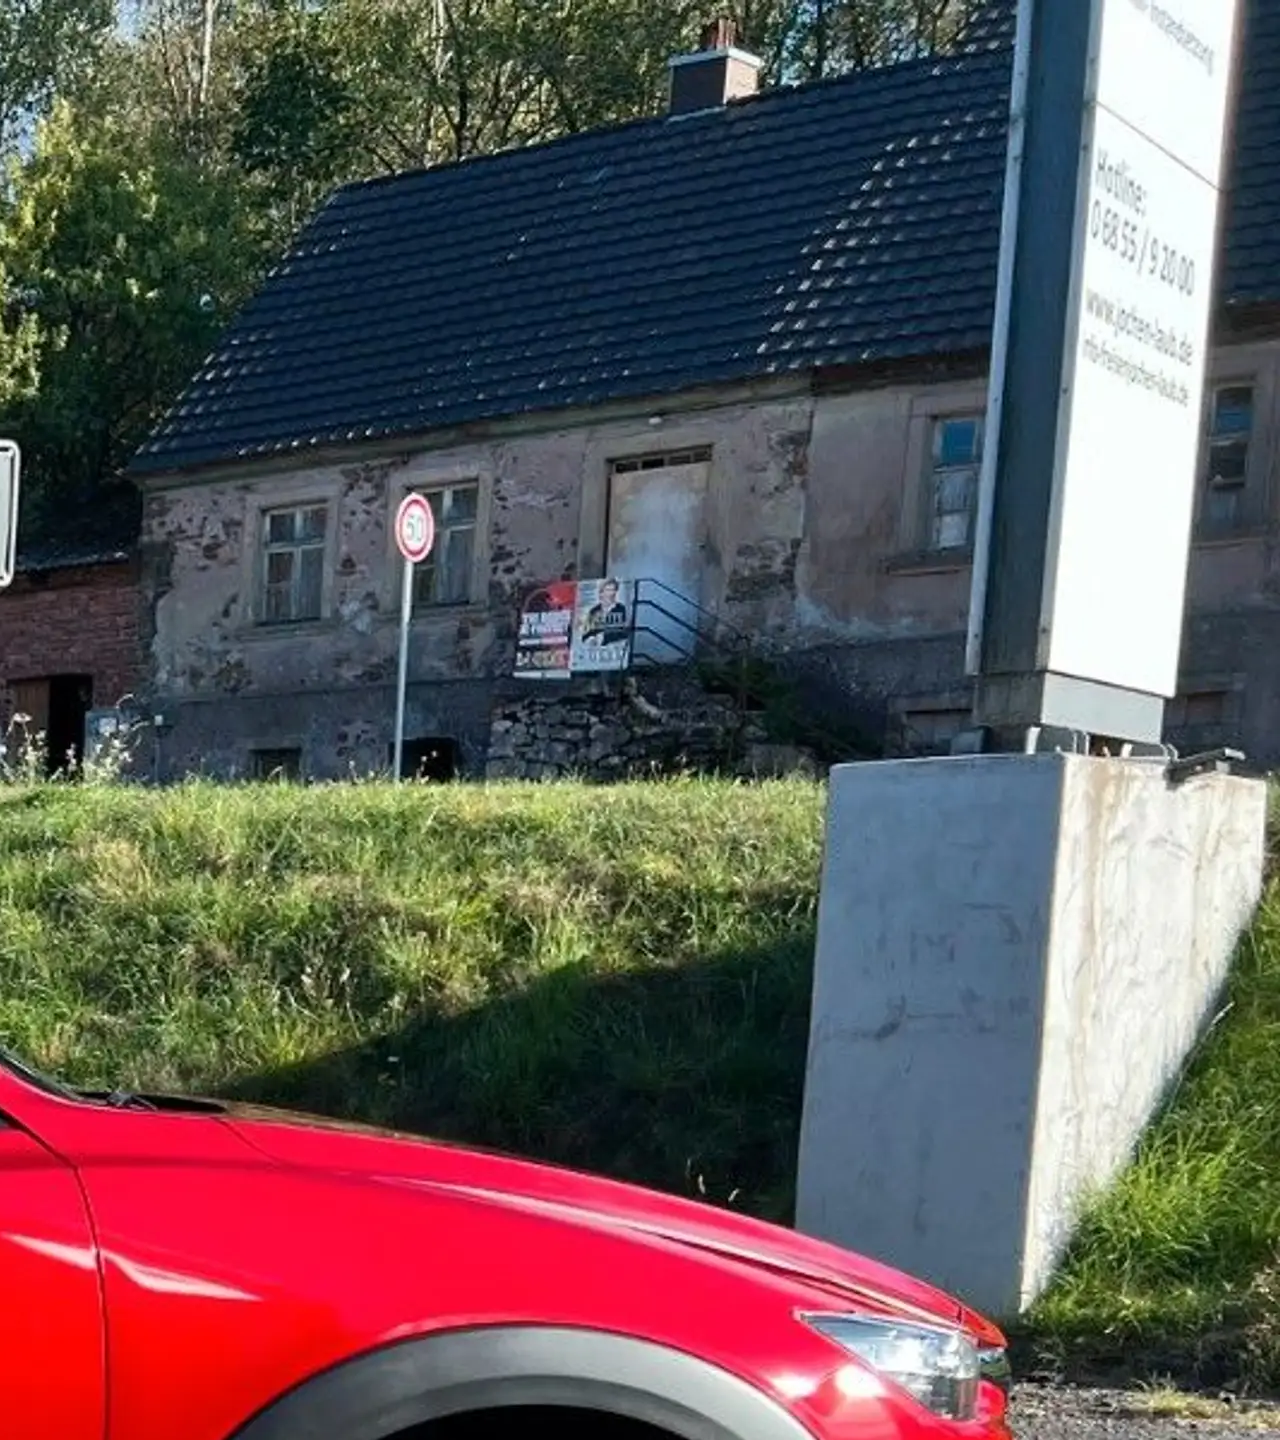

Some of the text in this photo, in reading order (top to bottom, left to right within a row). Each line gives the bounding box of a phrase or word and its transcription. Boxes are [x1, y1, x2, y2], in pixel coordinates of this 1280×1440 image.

[1096, 147, 1147, 218] Hotline:
[1090, 199, 1101, 239] 0
[1102, 207, 1119, 251] 68
[1120, 218, 1138, 263] 55
[1148, 236, 1159, 275] 9
[1159, 244, 1176, 288] 20
[1178, 255, 1195, 296] 00
